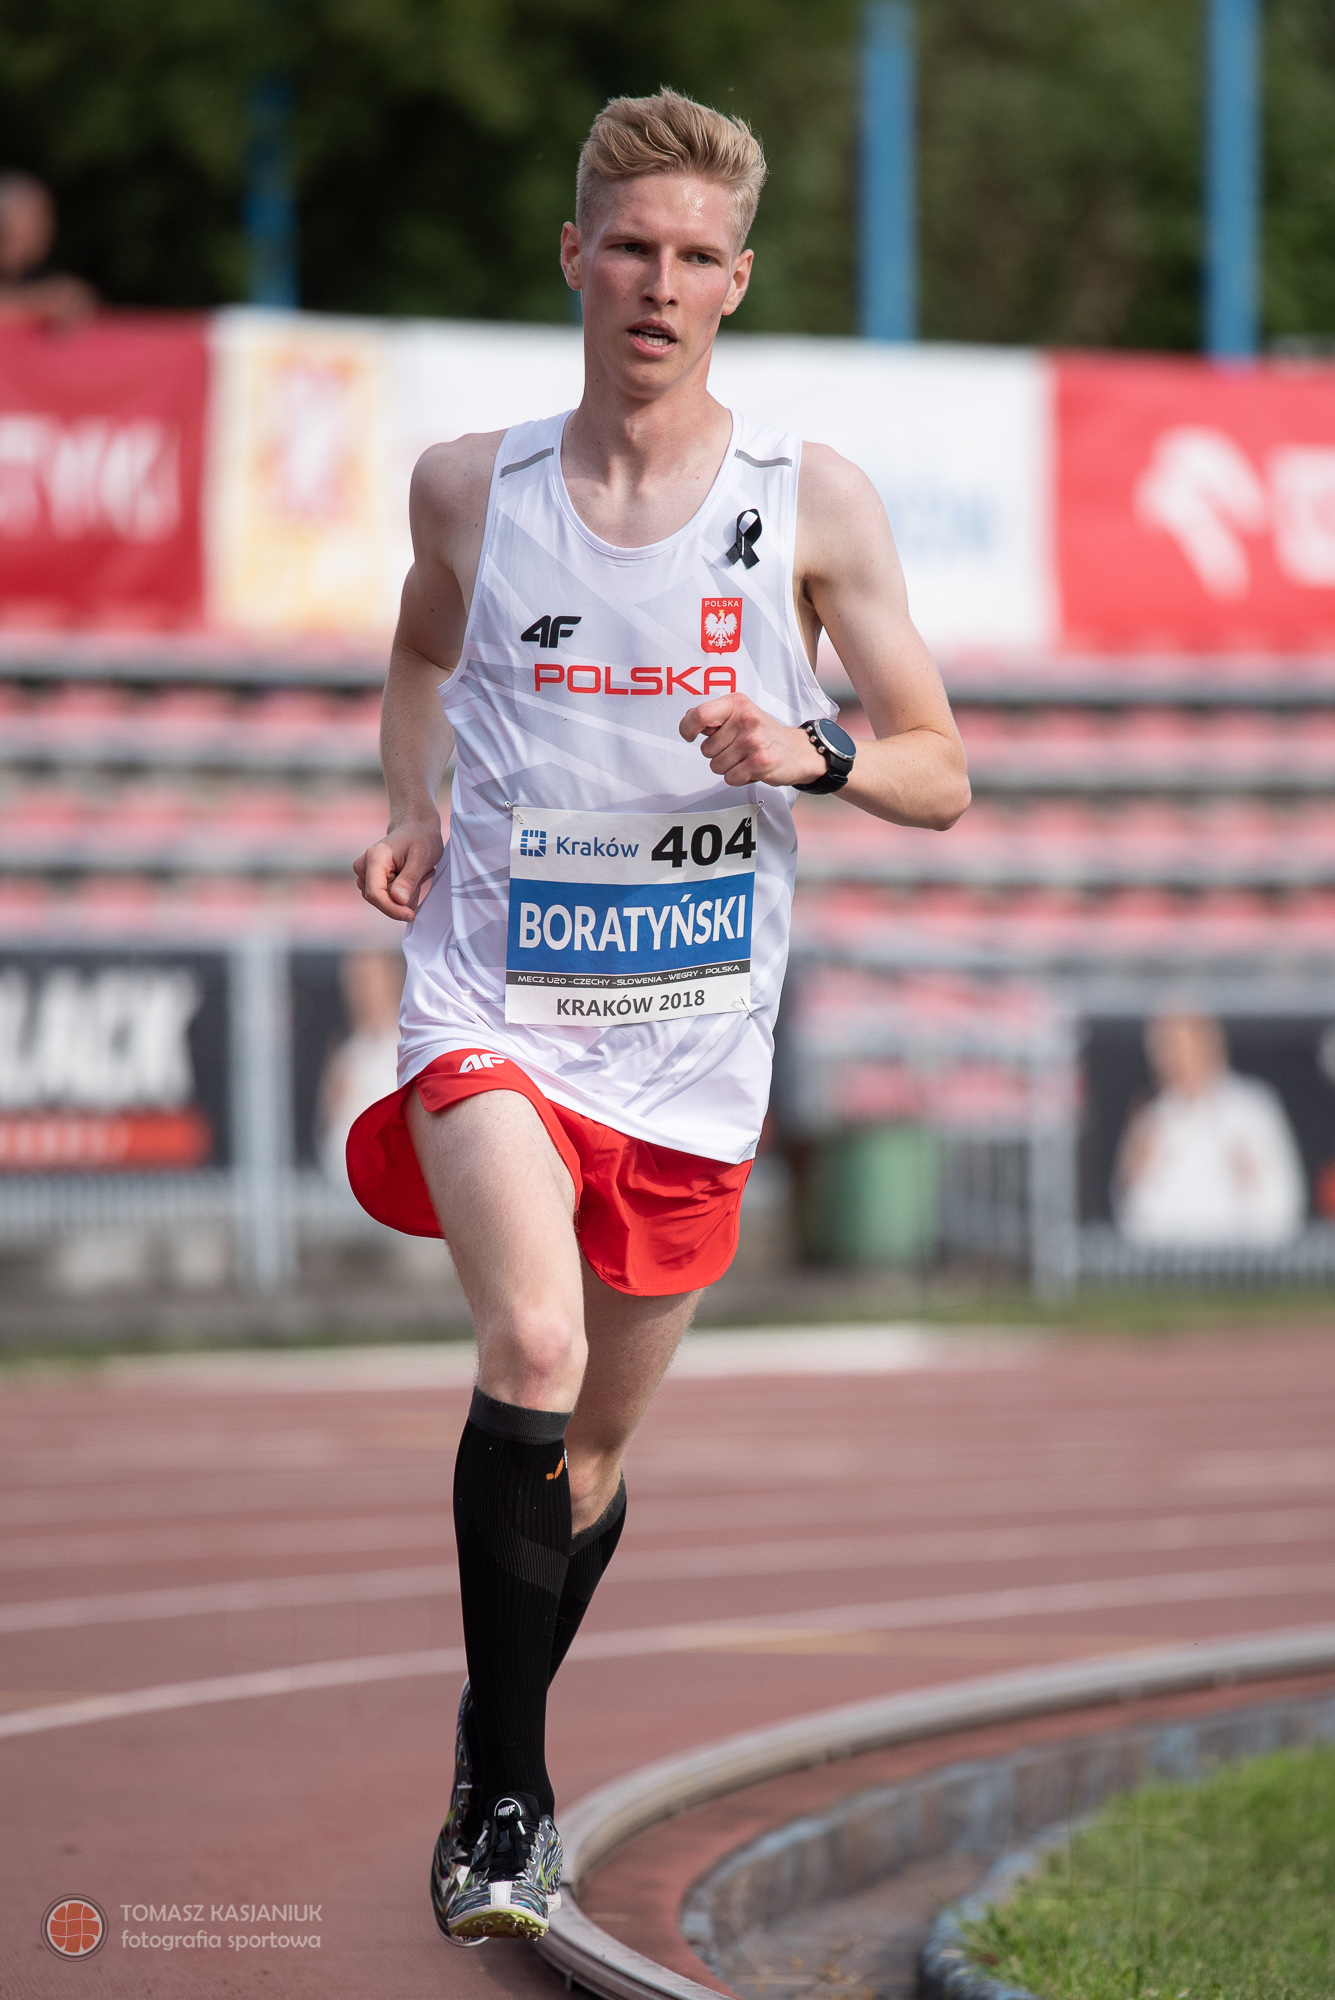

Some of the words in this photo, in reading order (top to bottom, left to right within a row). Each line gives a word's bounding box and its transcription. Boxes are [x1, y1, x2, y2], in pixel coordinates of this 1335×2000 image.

[520, 615, 582, 648] 4F
[534, 663, 737, 695] POLSKA
[556, 836, 639, 857] Kraków
[651, 817, 757, 868] 404
[518, 893, 746, 952] BORATYŃSKI
[517, 975, 545, 983] MECZ
[546, 977, 567, 985] U20
[705, 964, 740, 975] POLSKA
[556, 994, 654, 1017] KRAKÓW
[658, 989, 706, 1011] 2018
[497, 1804, 516, 1816] NIKE
